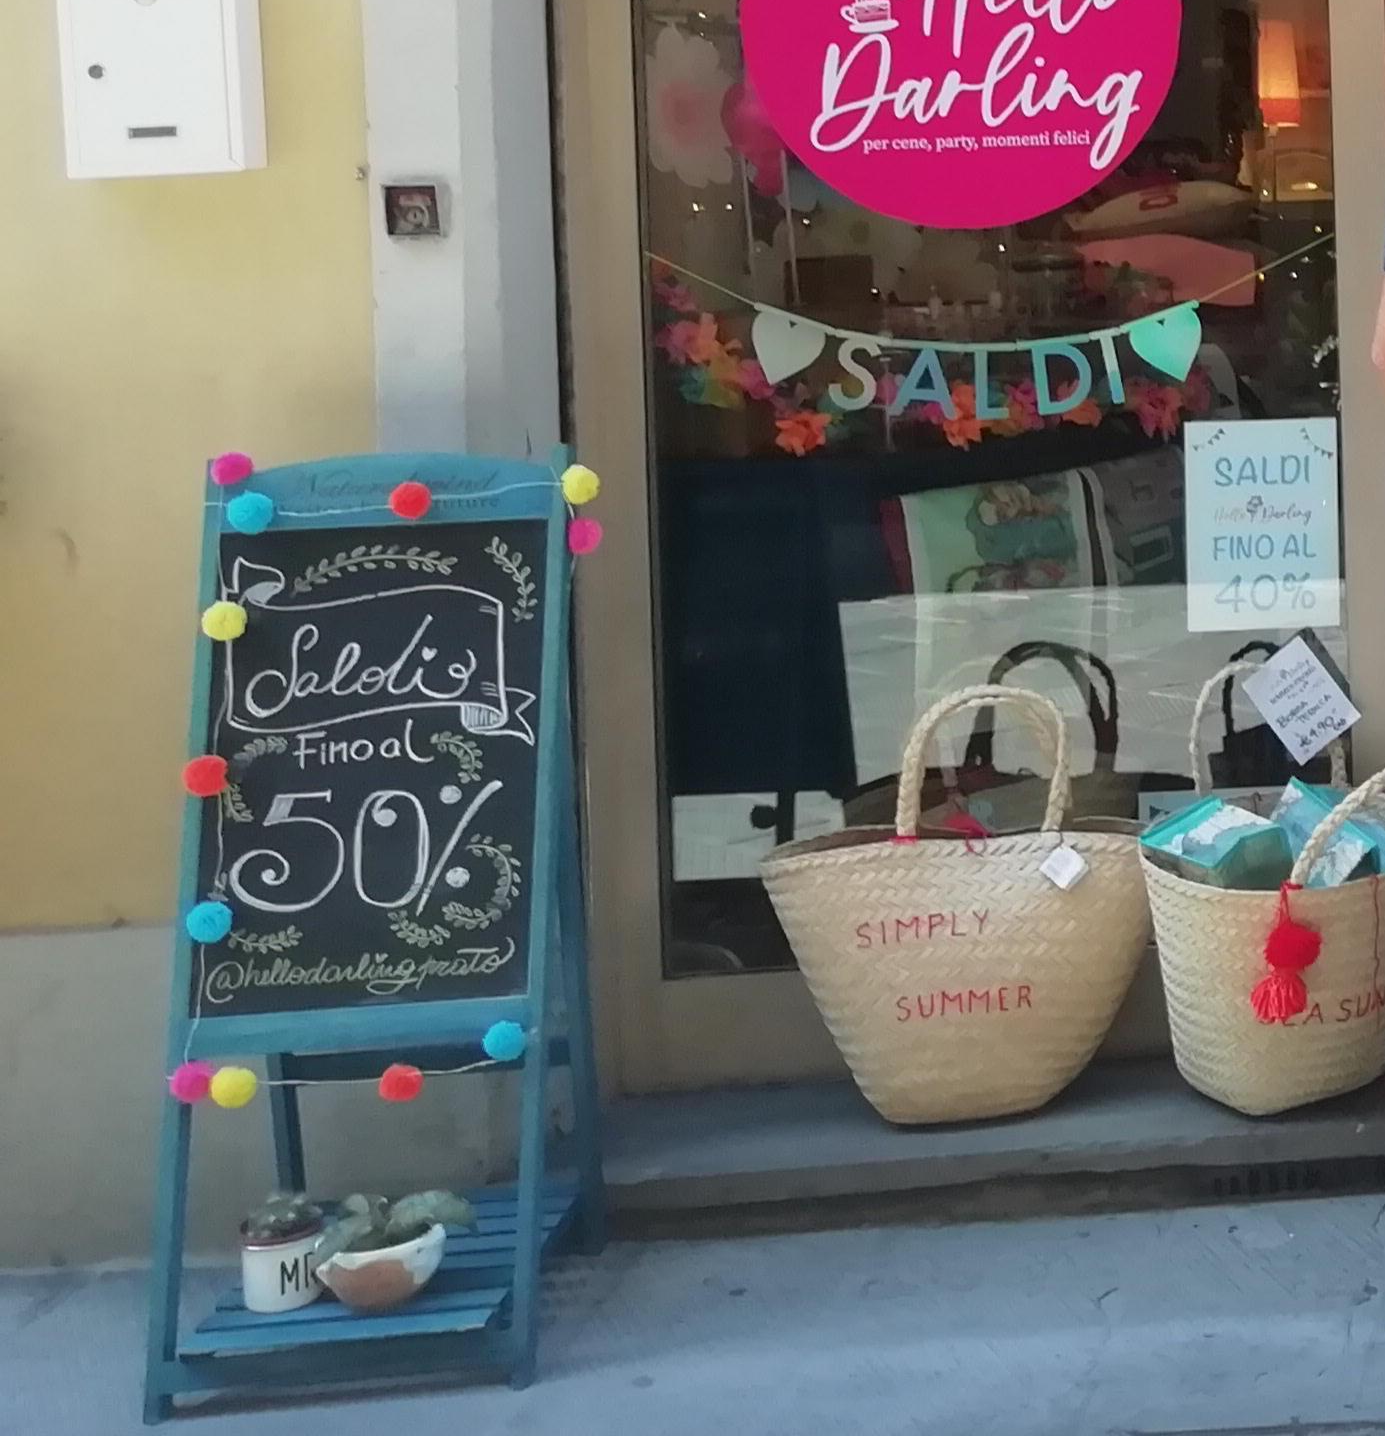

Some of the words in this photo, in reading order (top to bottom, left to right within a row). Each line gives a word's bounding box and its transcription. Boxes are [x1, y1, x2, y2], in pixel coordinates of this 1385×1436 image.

[810, 23, 1143, 170] Darling
[863, 138, 889, 154] per
[892, 139, 932, 152] cene,
[936, 136, 978, 152] party,
[982, 131, 1050, 147] momenti
[1053, 130, 1090, 145] felici
[828, 332, 1125, 421] SALDI
[1214, 455, 1310, 487] SALDI
[1213, 534, 1275, 561] FINO
[1282, 532, 1317, 558] AL
[1215, 572, 1316, 613] 40%
[245, 615, 477, 719] Saldi
[292, 730, 374, 769] Fino
[229, 780, 503, 916] 50%
[856, 908, 989, 949] SIMPLY
[896, 985, 1032, 1022] SUMMER
